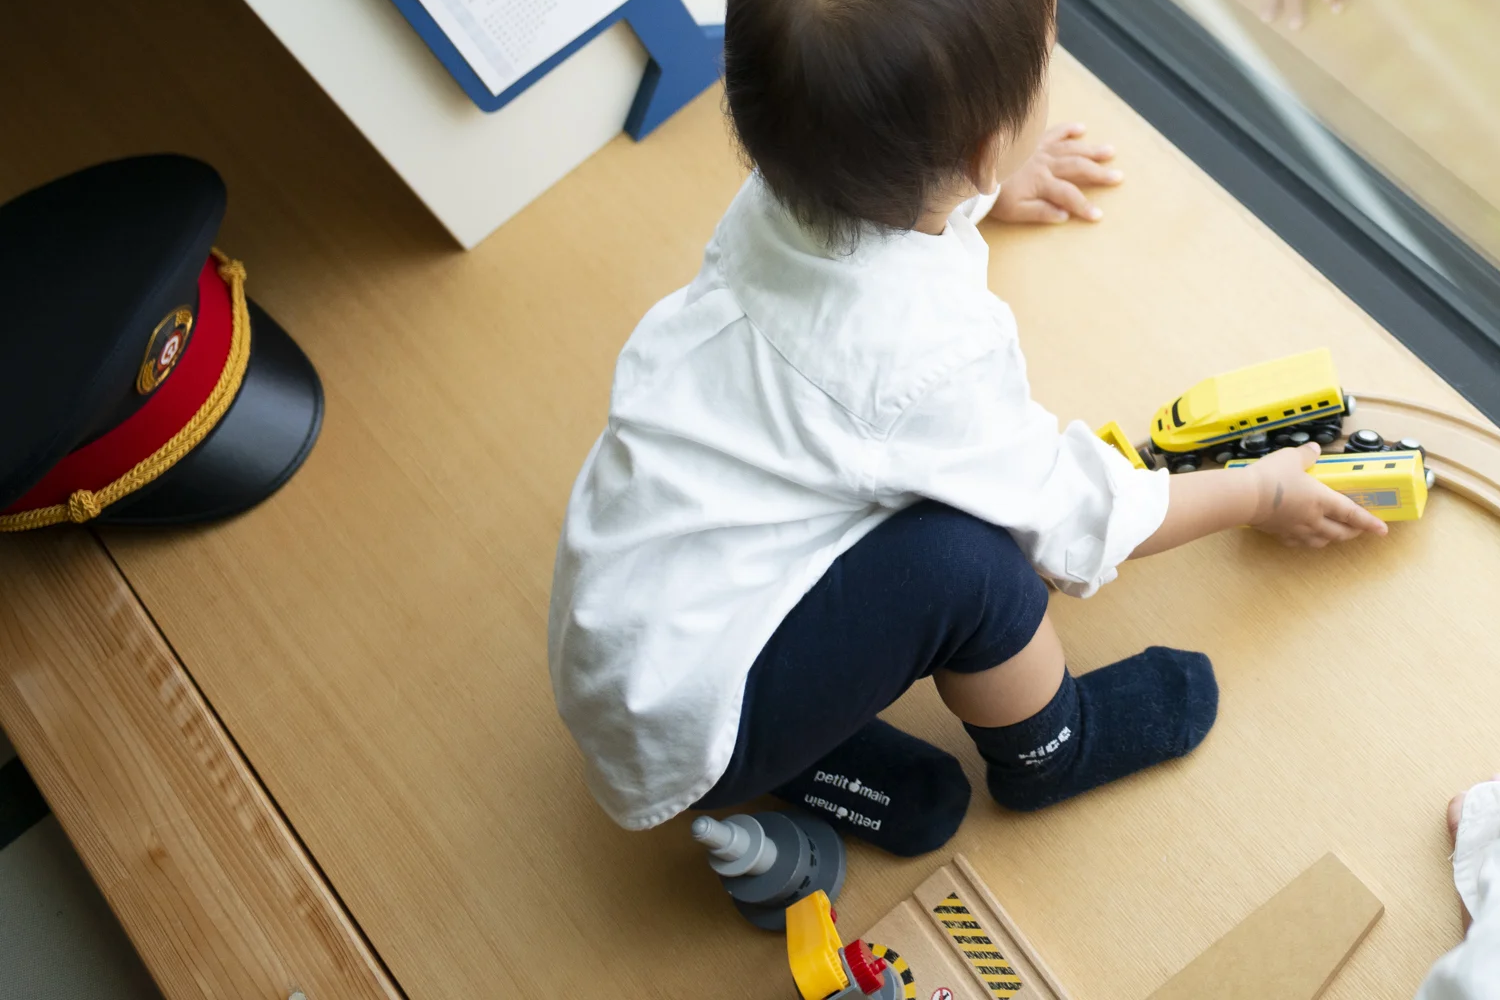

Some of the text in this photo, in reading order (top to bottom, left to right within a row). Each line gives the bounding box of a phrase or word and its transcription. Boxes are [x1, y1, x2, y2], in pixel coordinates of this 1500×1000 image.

[814, 770, 891, 806] petit main
[804, 793, 882, 831] petit main
